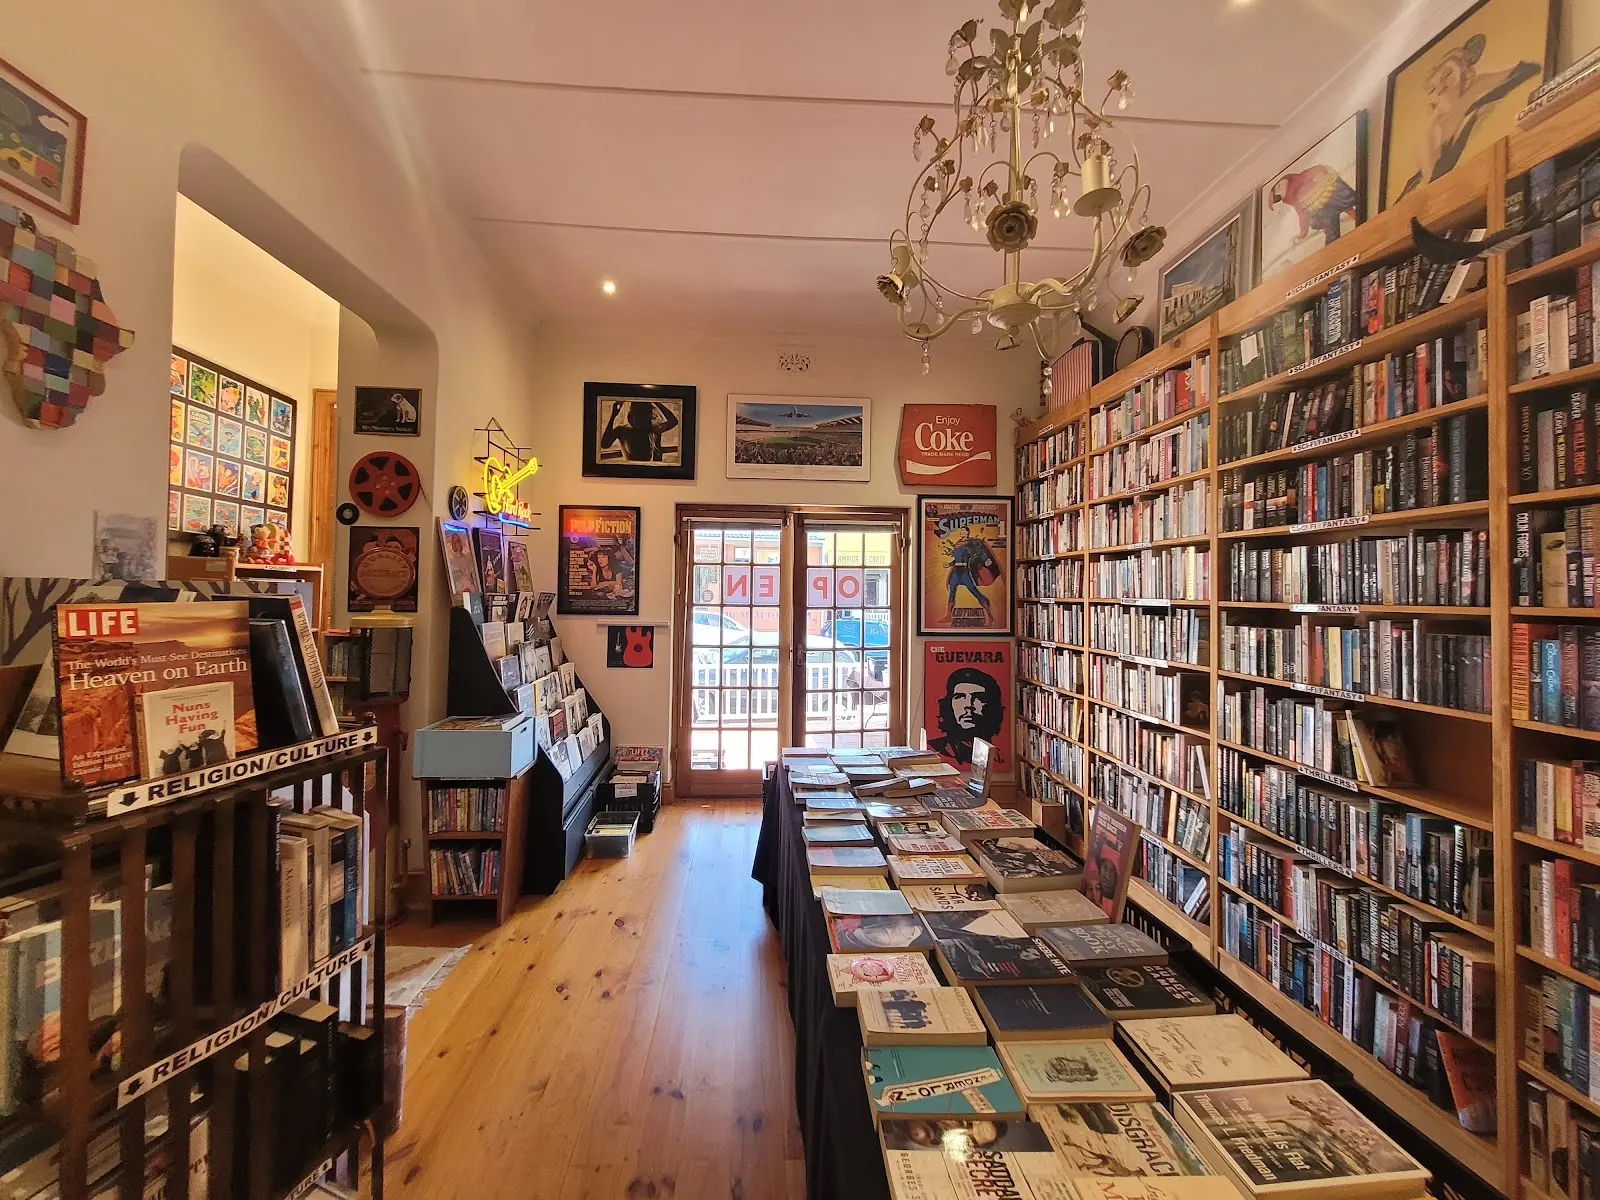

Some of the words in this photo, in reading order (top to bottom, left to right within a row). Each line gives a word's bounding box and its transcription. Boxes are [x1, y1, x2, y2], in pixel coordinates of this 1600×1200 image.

[1534, 343, 1546, 368] MICRO
[1571, 392, 1581, 419] DEAVER
[935, 415, 960, 426] Enjoy
[1554, 411, 1563, 434] DEAVER
[914, 422, 974, 451] Coke
[1573, 433, 1585, 450] KILL
[1556, 443, 1565, 457] SKIN
[1573, 451, 1586, 475] ROOM
[570, 519, 595, 534] PULP
[595, 517, 632, 534] FICTION
[938, 515, 1000, 539] SUPERMAN
[1516, 513, 1528, 532] COLIN
[1516, 533, 1530, 558] FORBES
[1567, 572, 1577, 587] Mercy
[1583, 557, 1595, 577] Blood
[1584, 577, 1595, 597] Storm
[68, 610, 137, 636] LIFE
[297, 612, 311, 643] WHALES
[67, 659, 92, 671] The
[94, 655, 138, 669] World's
[140, 650, 188, 665] Must-See
[190, 647, 247, 660] Destinations
[935, 651, 1004, 663] GUEVARA
[69, 669, 156, 692] Heaven
[162, 667, 191, 681] on
[195, 657, 248, 677] Earth
[164, 710, 219, 726] Having
[172, 701, 211, 714] Nuns
[178, 721, 206, 734] Fun
[147, 733, 359, 802] RELIGION/CULTURE
[1305, 768, 1351, 788] THRILLERS
[1302, 849, 1344, 874] THRILLERS
[929, 886, 954, 910] SANDS
[1069, 927, 1110, 955] BOOK
[1370, 915, 1378, 947] BROWN
[1032, 938, 1056, 959] SHERE
[1050, 958, 1072, 975] HITE
[1303, 931, 1346, 963] THRILLERS
[1143, 965, 1185, 1000] GAMES
[1152, 965, 1202, 1004] HUNGER
[1543, 975, 1557, 1030] COMPULSION
[152, 948, 359, 1083] RELIGION/CULTURE
[962, 1006, 980, 1031] GILBERT
[1085, 1046, 1103, 1065] HER
[1101, 1065, 1121, 1087] FACE
[1099, 1051, 1129, 1081] COVER
[1194, 1093, 1229, 1126] Thomas
[1231, 1136, 1278, 1182] Friedman
[1232, 1097, 1252, 1112] The
[1247, 1112, 1283, 1138] World
[1282, 1151, 1311, 1171] Flat
[900, 1152, 918, 1185] GEORGES
